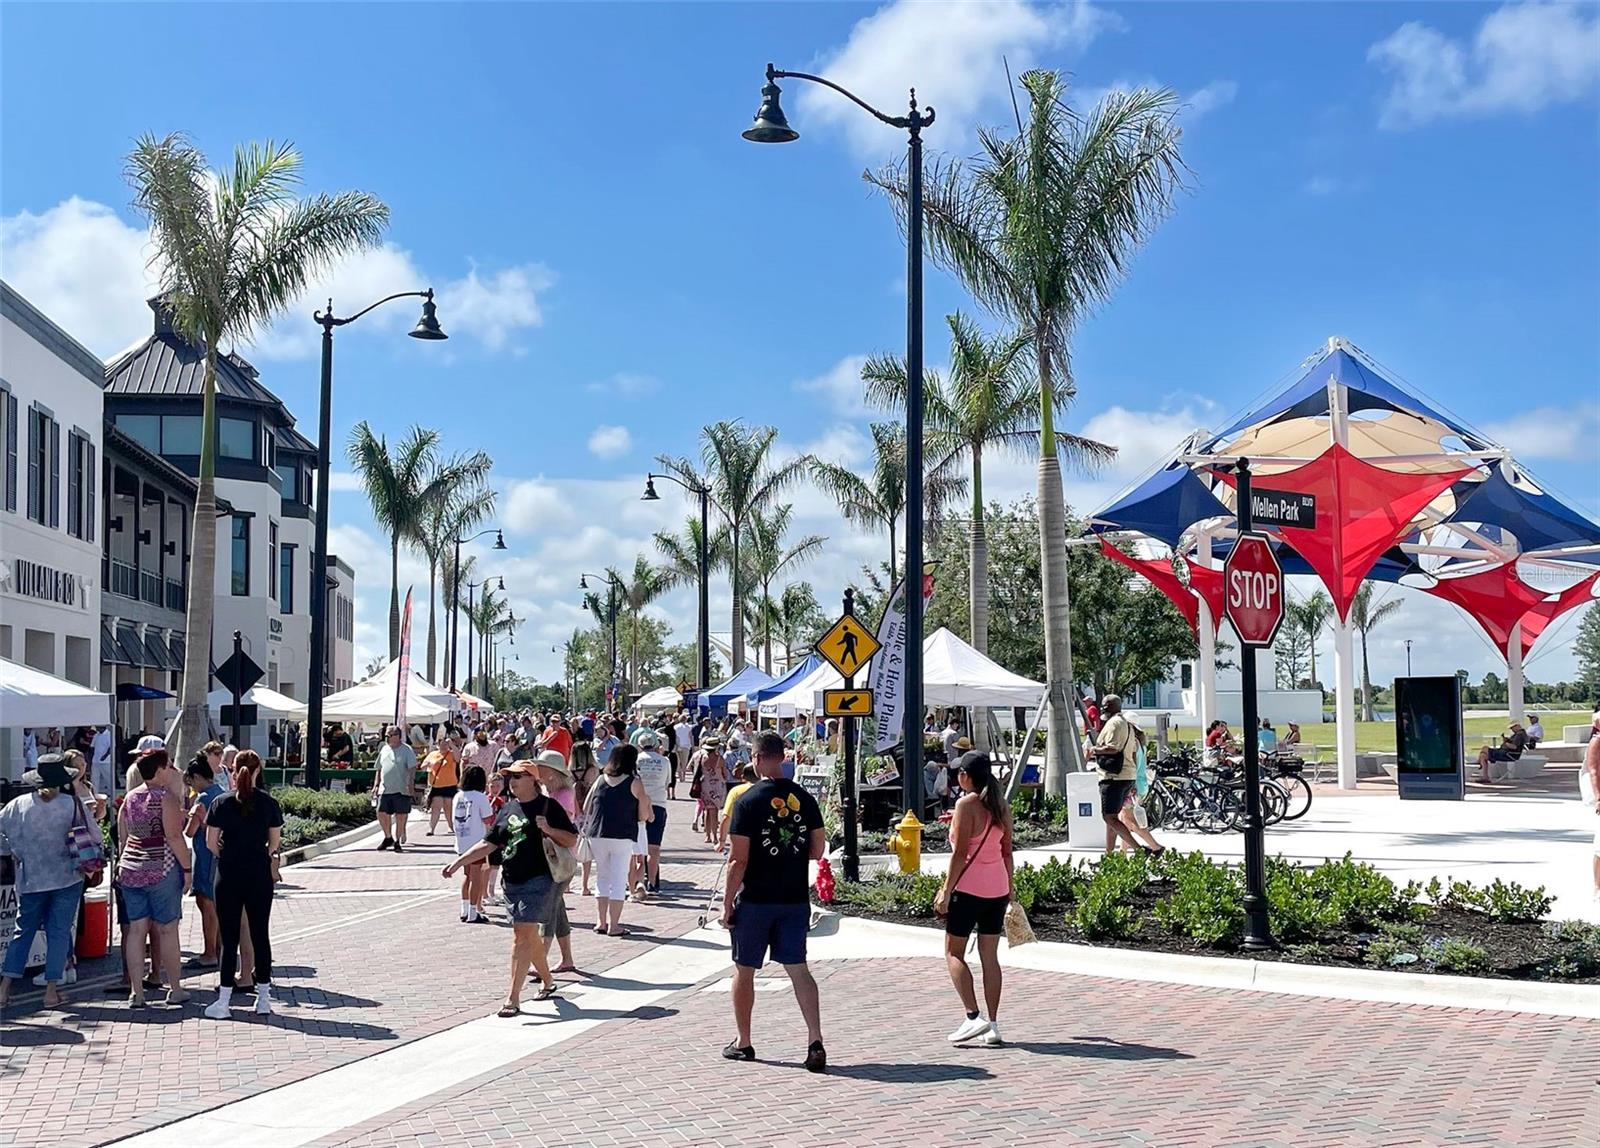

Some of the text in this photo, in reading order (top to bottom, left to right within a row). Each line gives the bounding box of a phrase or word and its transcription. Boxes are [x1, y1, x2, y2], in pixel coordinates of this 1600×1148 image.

[1252, 496, 1300, 521] Wellen Park
[1302, 496, 1314, 507] BLVD
[17, 559, 53, 601] VILLANI
[1230, 569, 1278, 610] STOP
[889, 653, 903, 666] &
[884, 668, 900, 700] Herb
[876, 702, 895, 742] Plants
